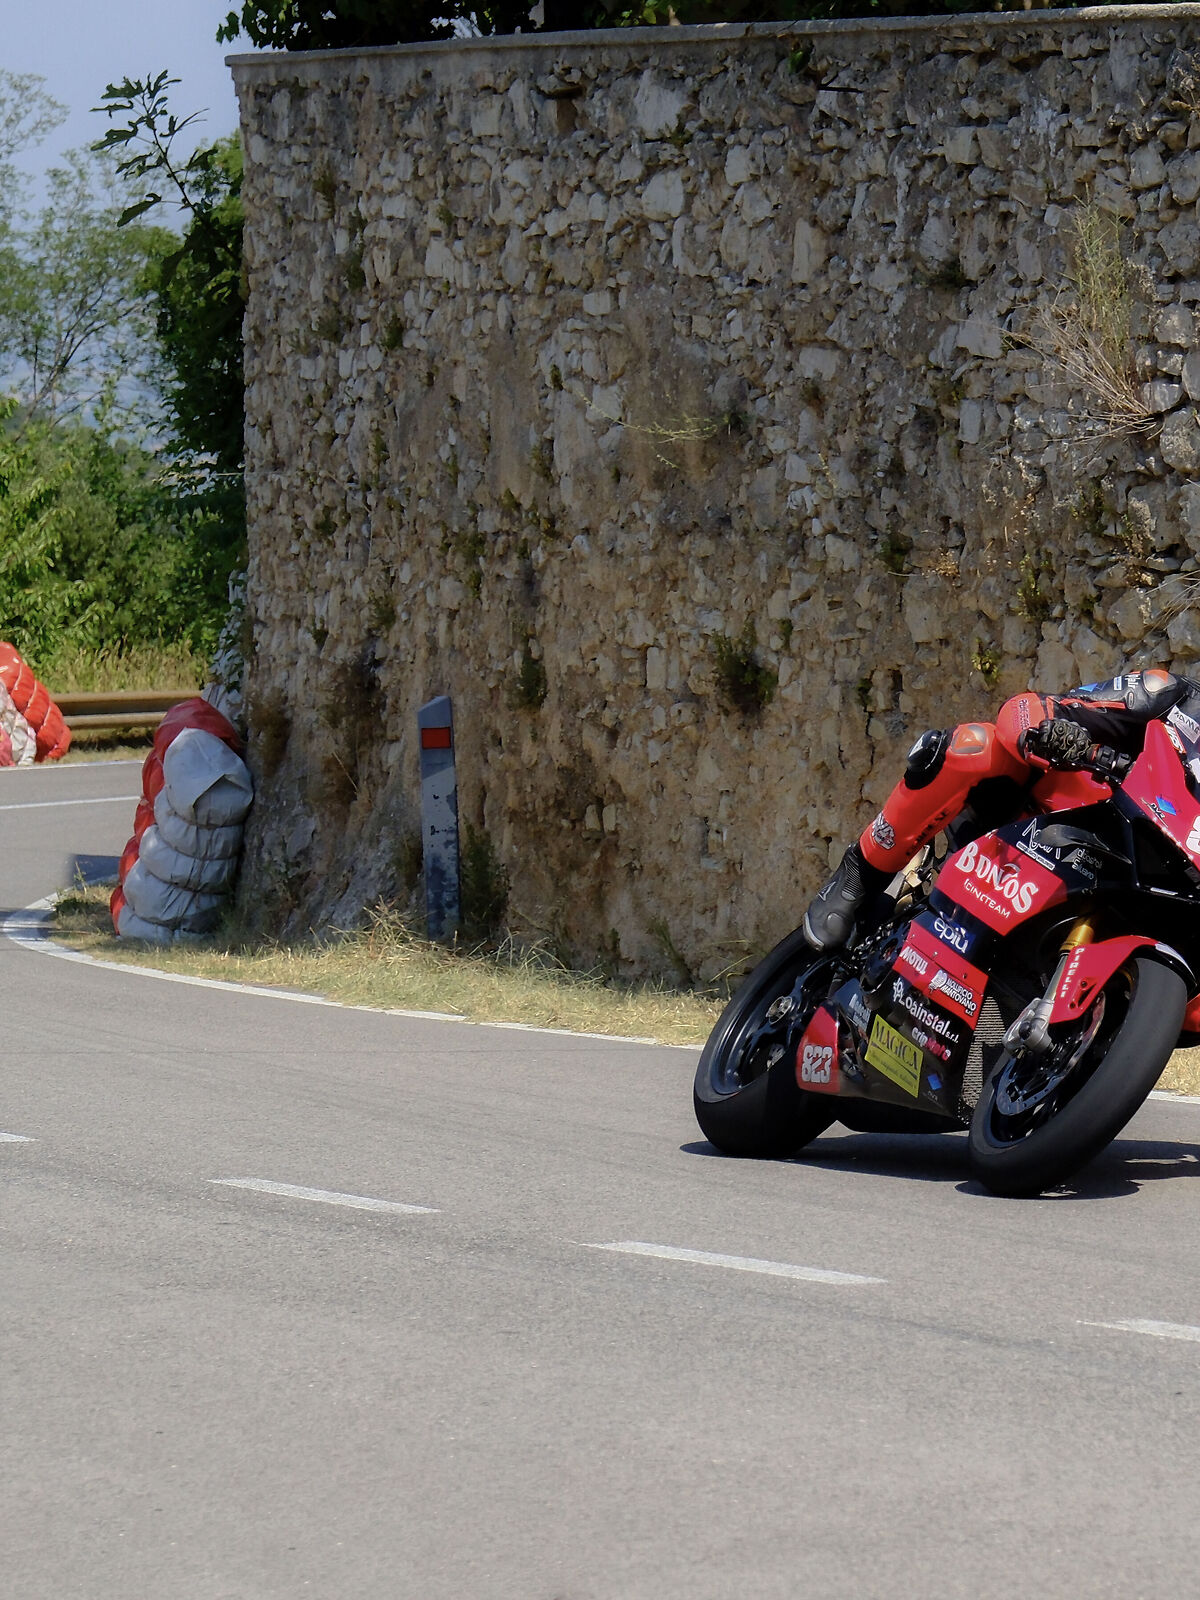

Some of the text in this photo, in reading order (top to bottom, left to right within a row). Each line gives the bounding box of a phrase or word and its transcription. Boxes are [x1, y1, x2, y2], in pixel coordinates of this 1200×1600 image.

[899, 946, 928, 975] MOTUL
[940, 984, 977, 1011] MANTOVANO
[874, 1020, 919, 1071] MAGICA
[801, 1045, 833, 1084] 823
